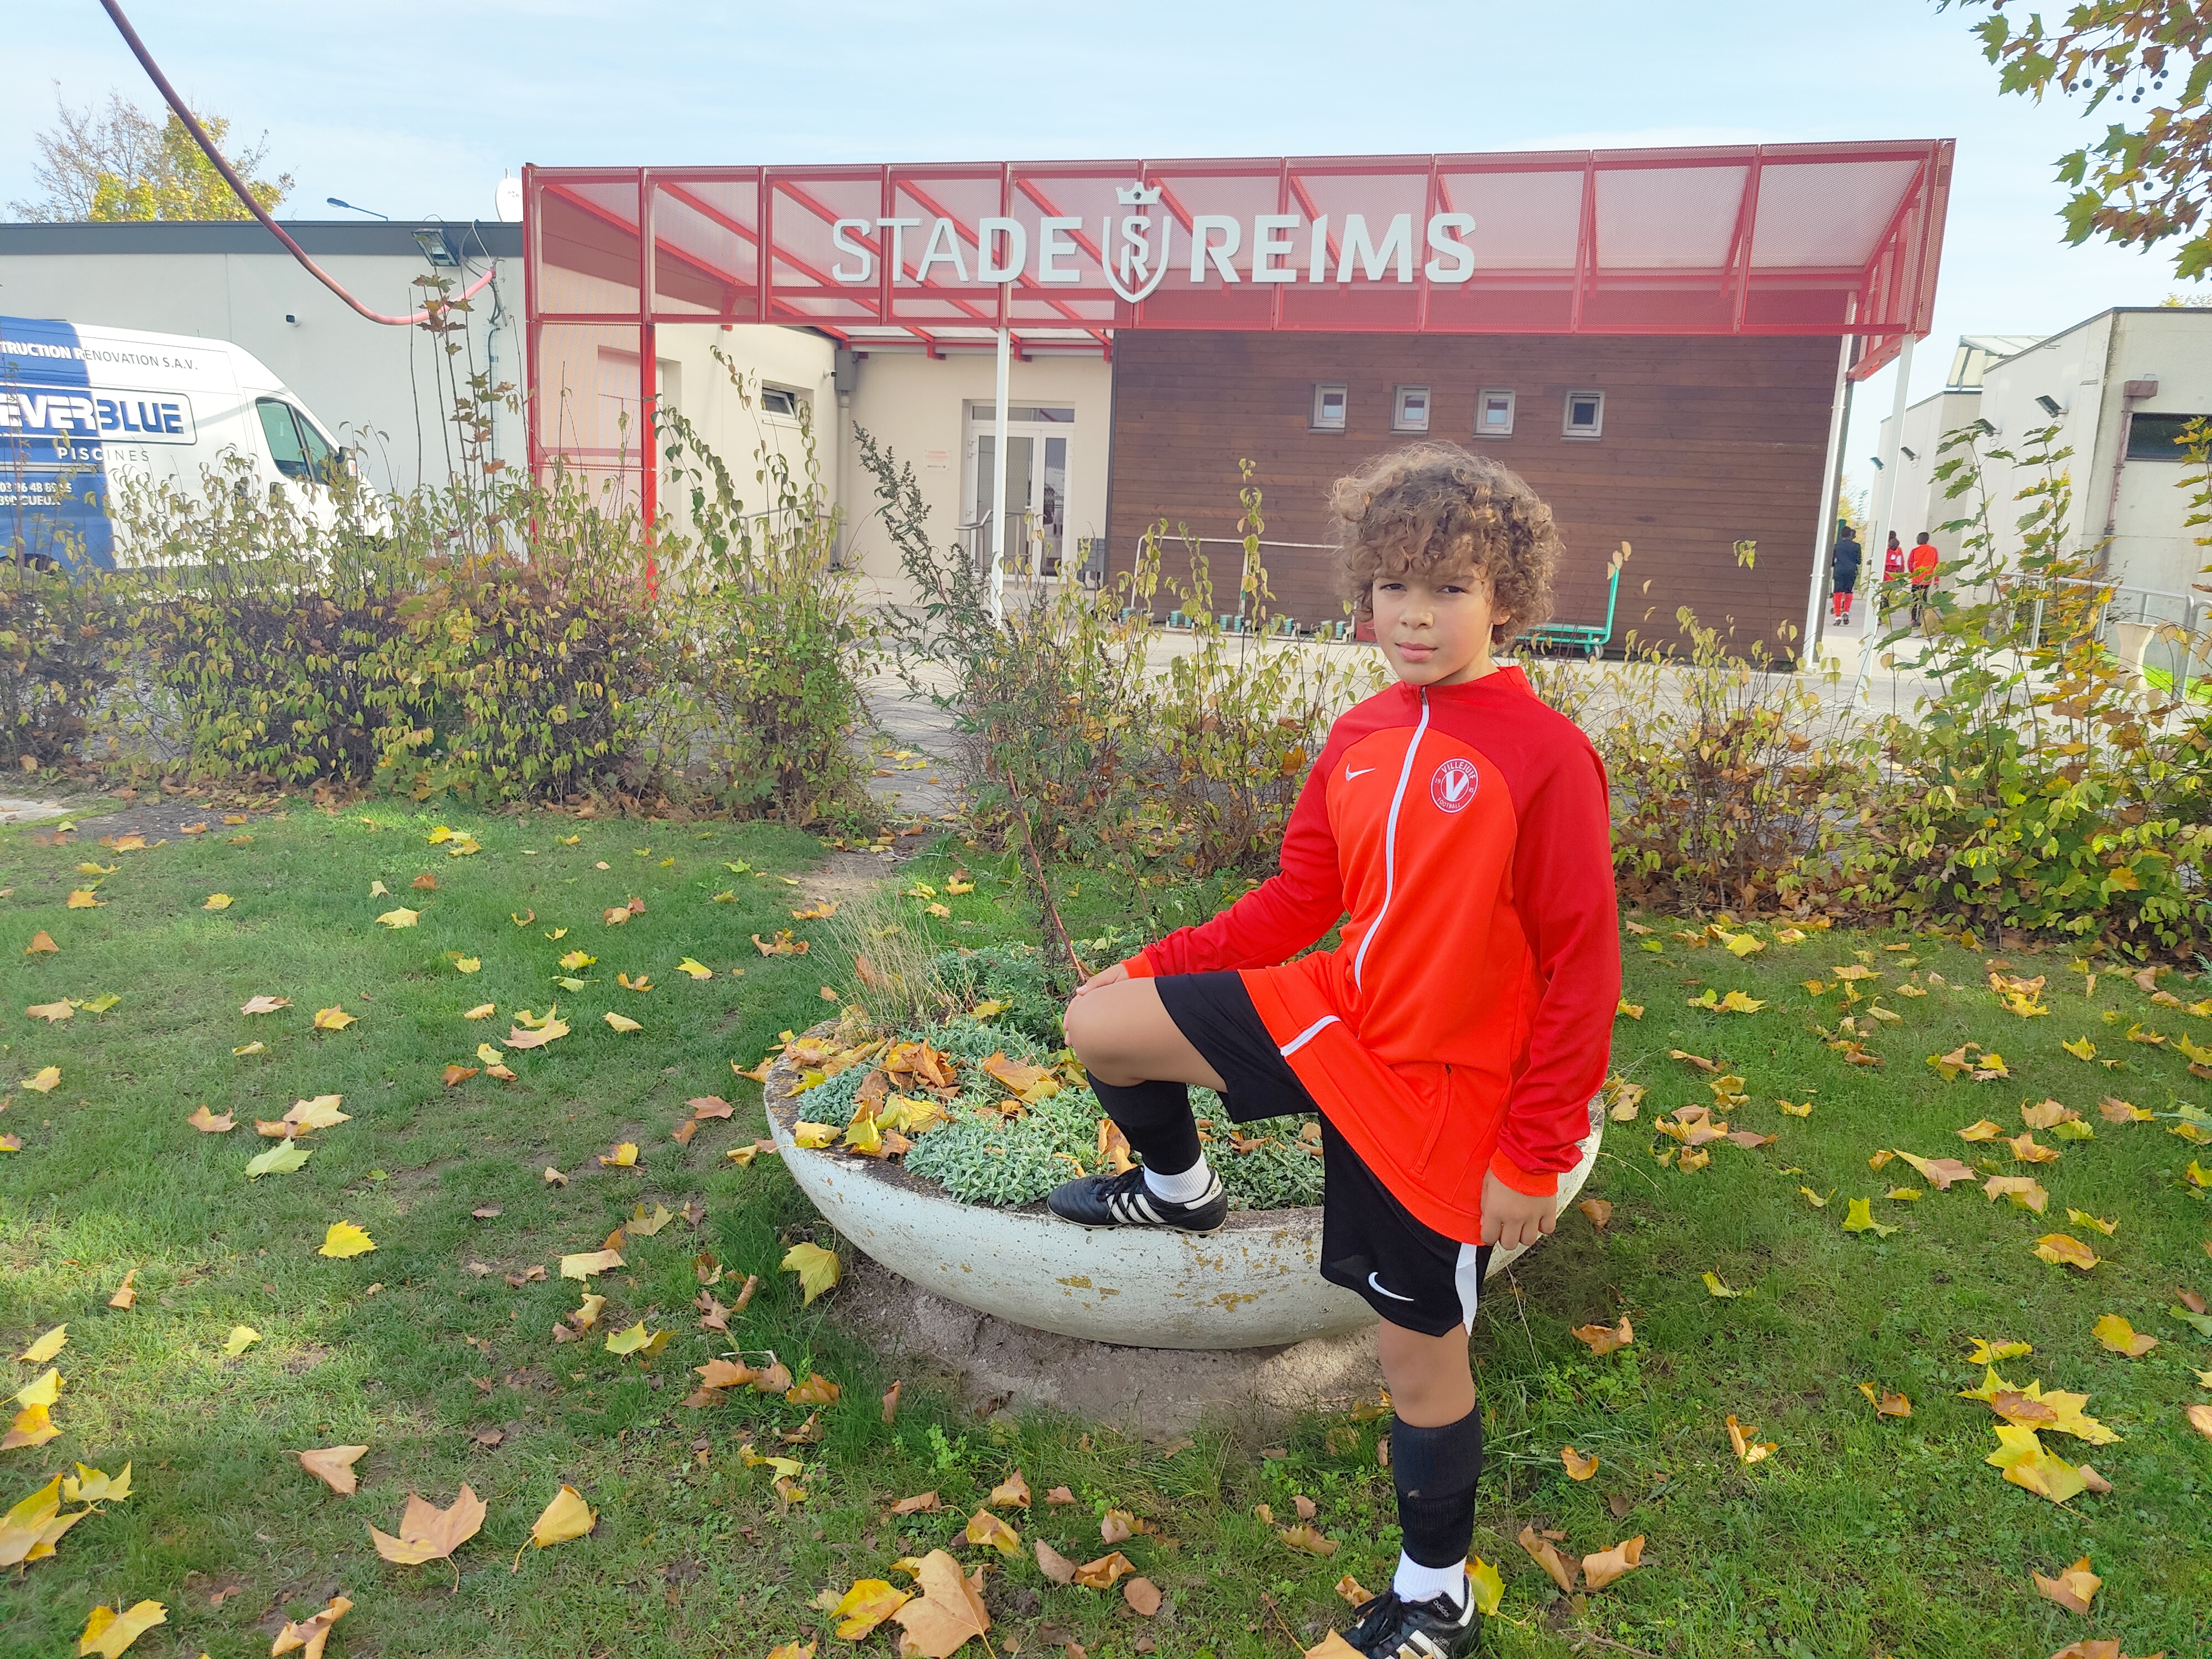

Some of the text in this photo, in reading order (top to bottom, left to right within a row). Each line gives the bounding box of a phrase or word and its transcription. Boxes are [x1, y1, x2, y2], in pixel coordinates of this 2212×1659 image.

[832, 213, 1476, 283] STADE REIMS
[0, 340, 198, 370] TRUCTION RÉNOVATION S.A.V.
[0, 393, 184, 435] EVERBLUE
[58, 447, 149, 462] PISCINES
[29, 482, 43, 493] 48
[1441, 761, 1475, 780] VILLEJUIF
[1437, 796, 1461, 809] FOOTBALL
[1433, 1600, 1451, 1618] adida
